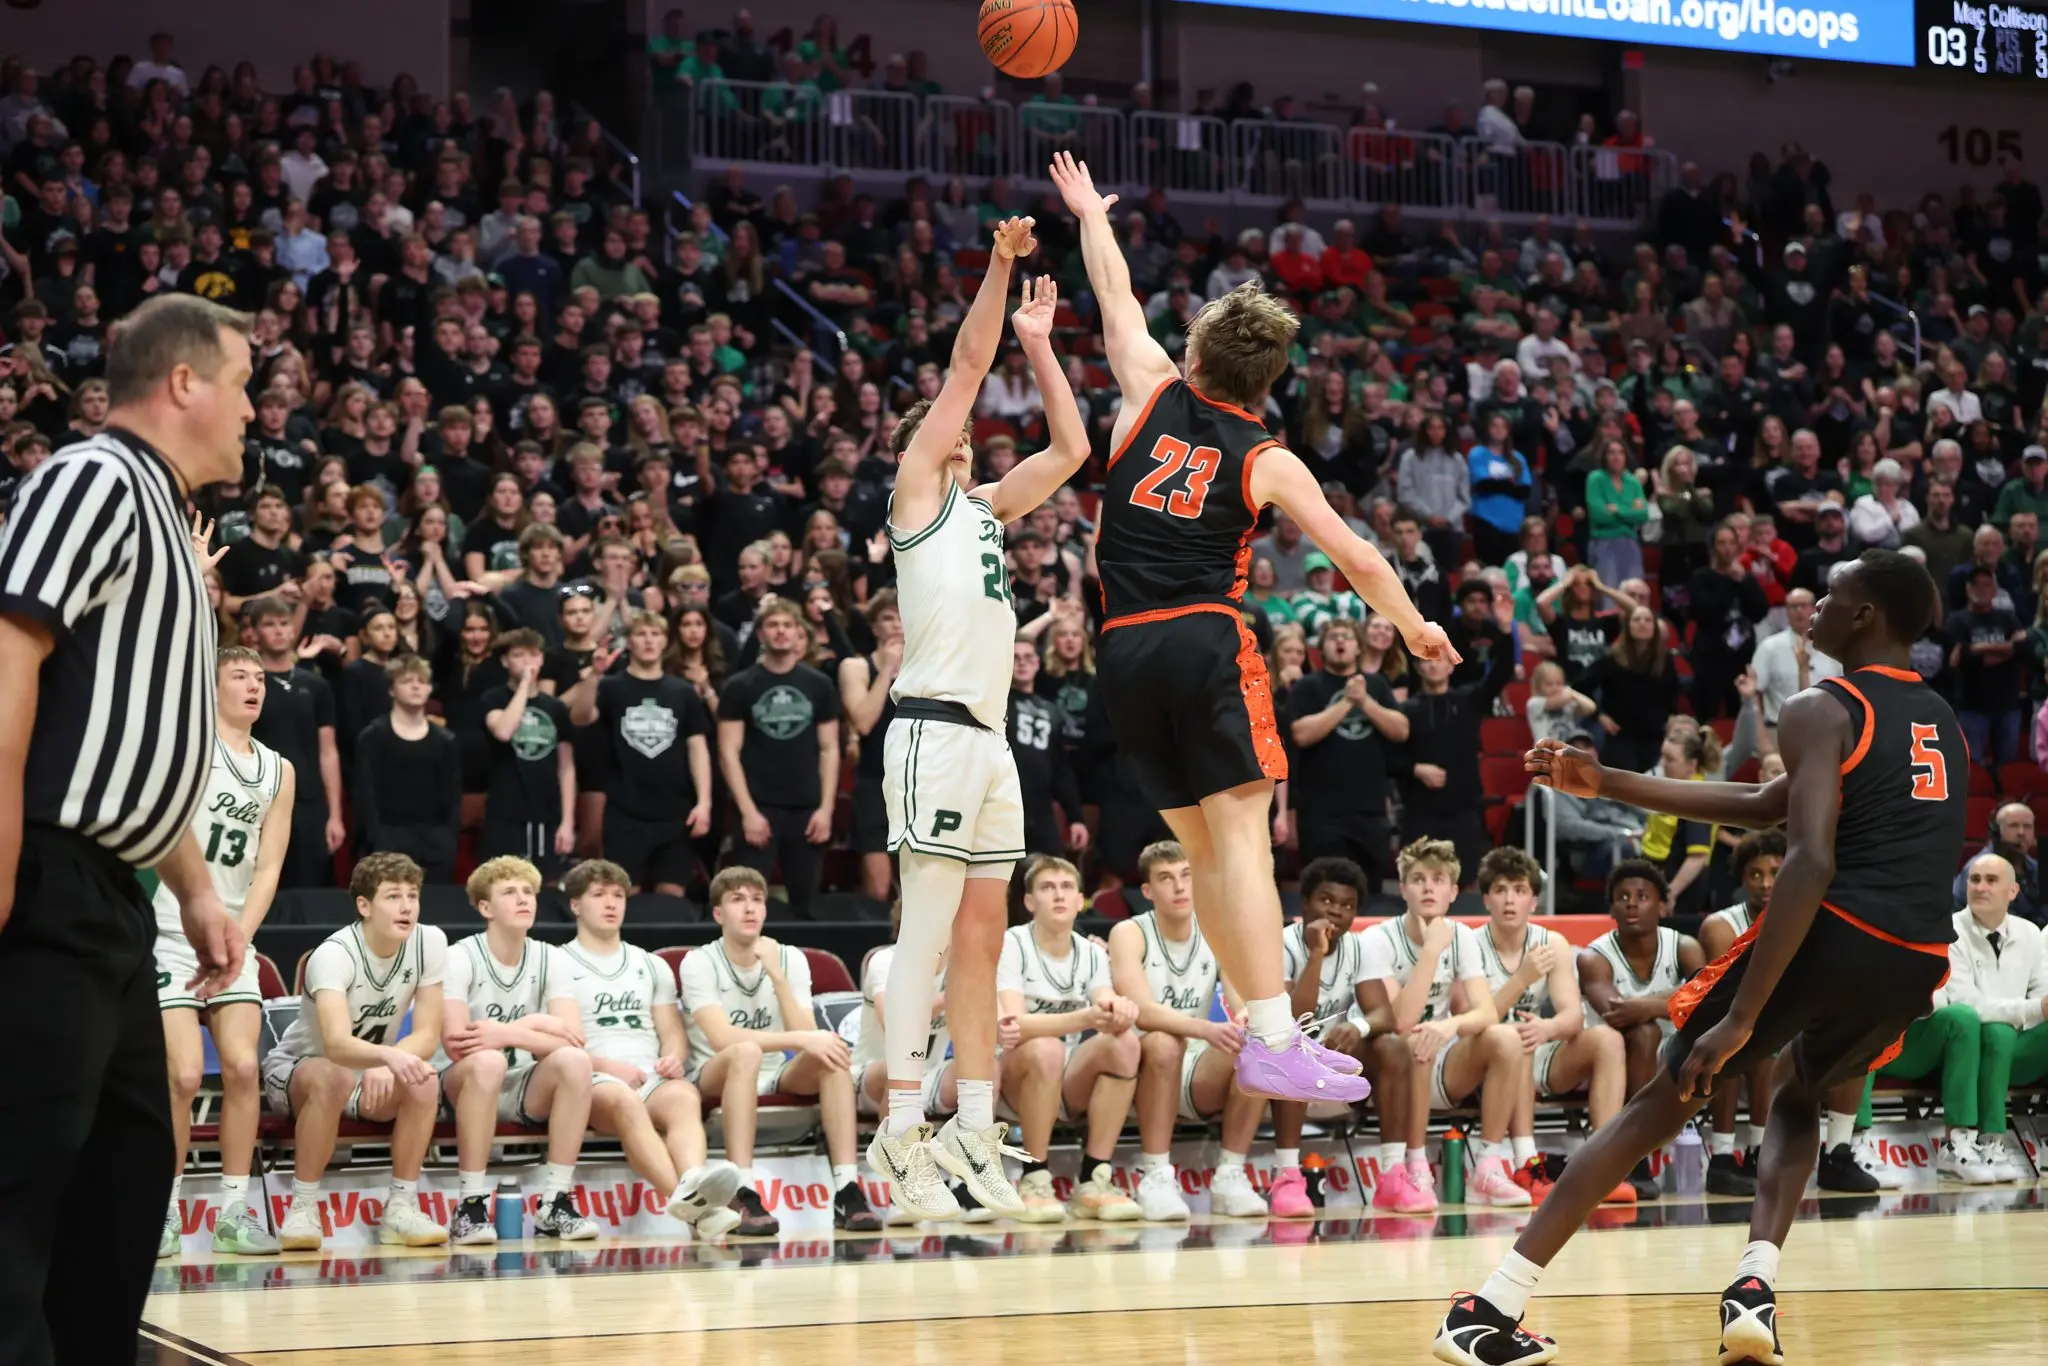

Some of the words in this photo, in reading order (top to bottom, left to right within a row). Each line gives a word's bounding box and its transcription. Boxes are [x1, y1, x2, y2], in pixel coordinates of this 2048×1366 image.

[1928, 25, 1967, 67] 03
[1974, 47, 1988, 73] 5
[1995, 51, 2023, 74] AST
[1937, 124, 2023, 168] 105
[1129, 434, 1222, 519] 23
[1016, 712, 1051, 750] 53
[1909, 721, 1949, 801] 5
[929, 808, 963, 838] P
[204, 822, 248, 868] 13
[591, 990, 644, 1014] Pella
[1160, 985, 1200, 1010] Pella
